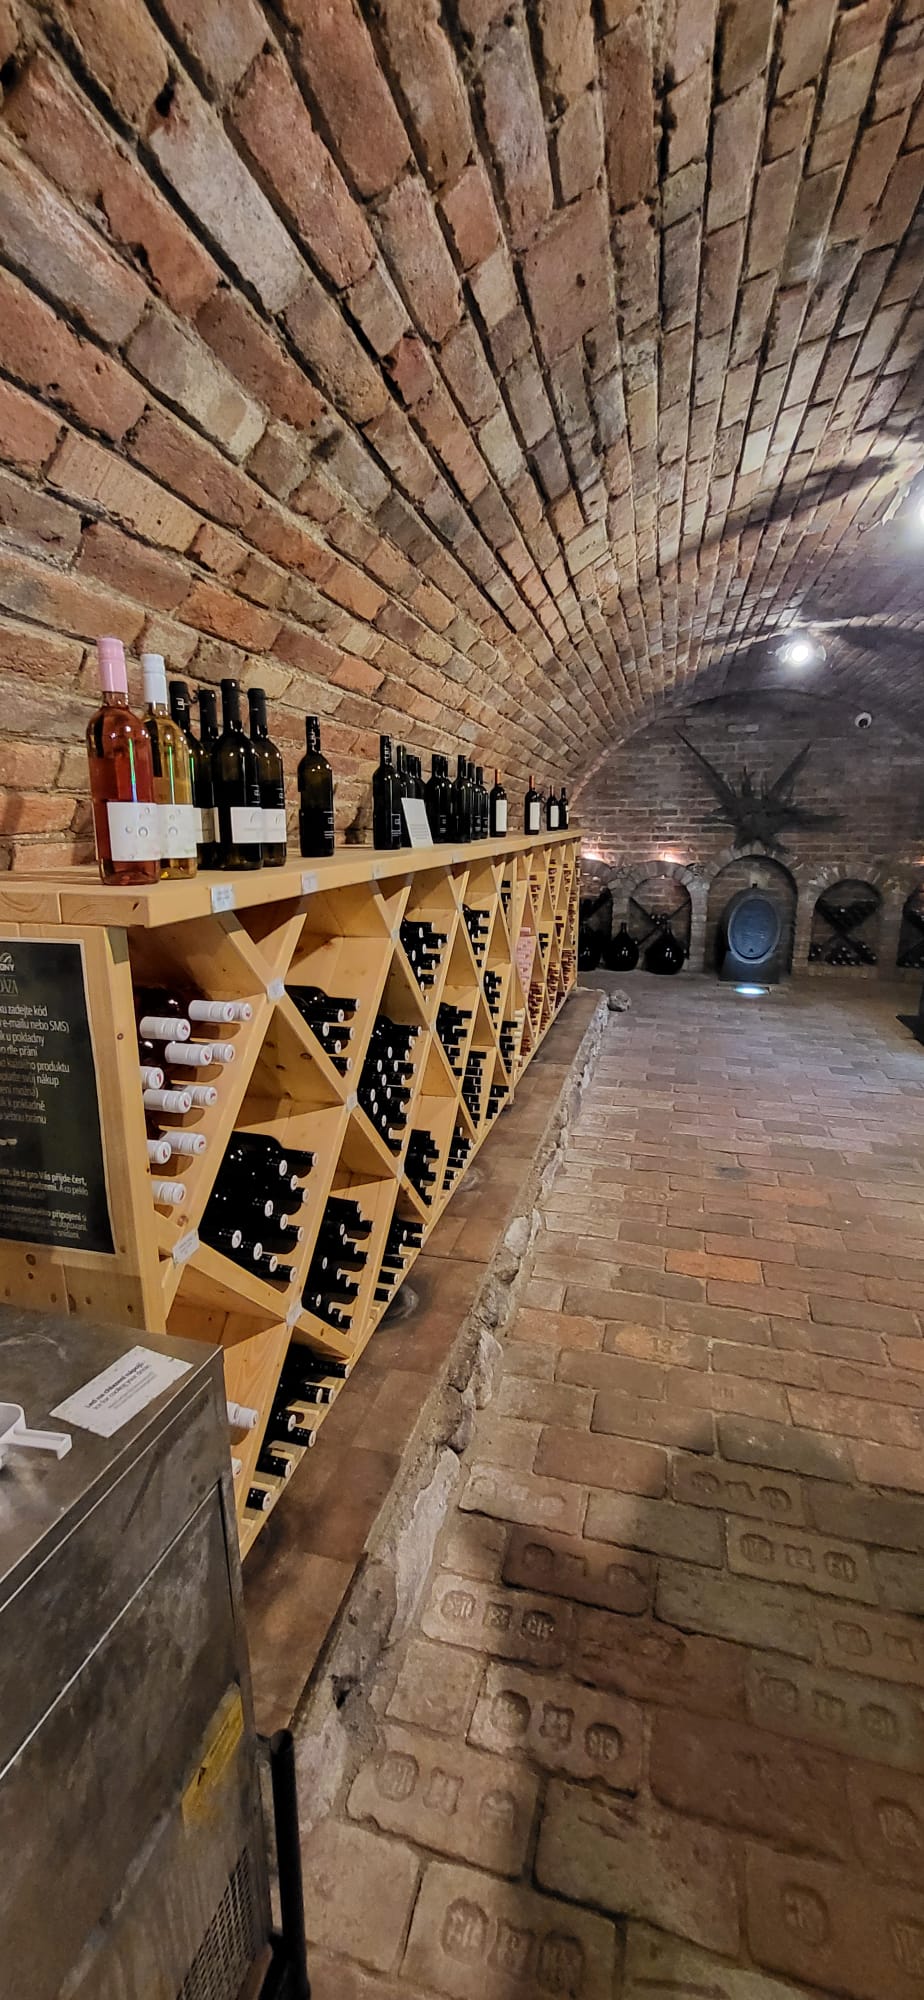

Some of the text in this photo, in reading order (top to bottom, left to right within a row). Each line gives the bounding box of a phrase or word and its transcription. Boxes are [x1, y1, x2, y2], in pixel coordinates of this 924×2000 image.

[8, 1004, 33, 1018] zadejte
[33, 1004, 48, 1017] kód
[31, 1019, 49, 1031] nebo
[49, 1020, 70, 1034] SMS)
[12, 1032, 45, 1047] pokladny
[7, 1045, 18, 1056] dle
[19, 1045, 38, 1058] přání
[37, 1059, 70, 1073] produktu
[37, 1072, 60, 1088] nákup
[52, 1172, 71, 1187] přijde
[72, 1174, 88, 1187] čert,
